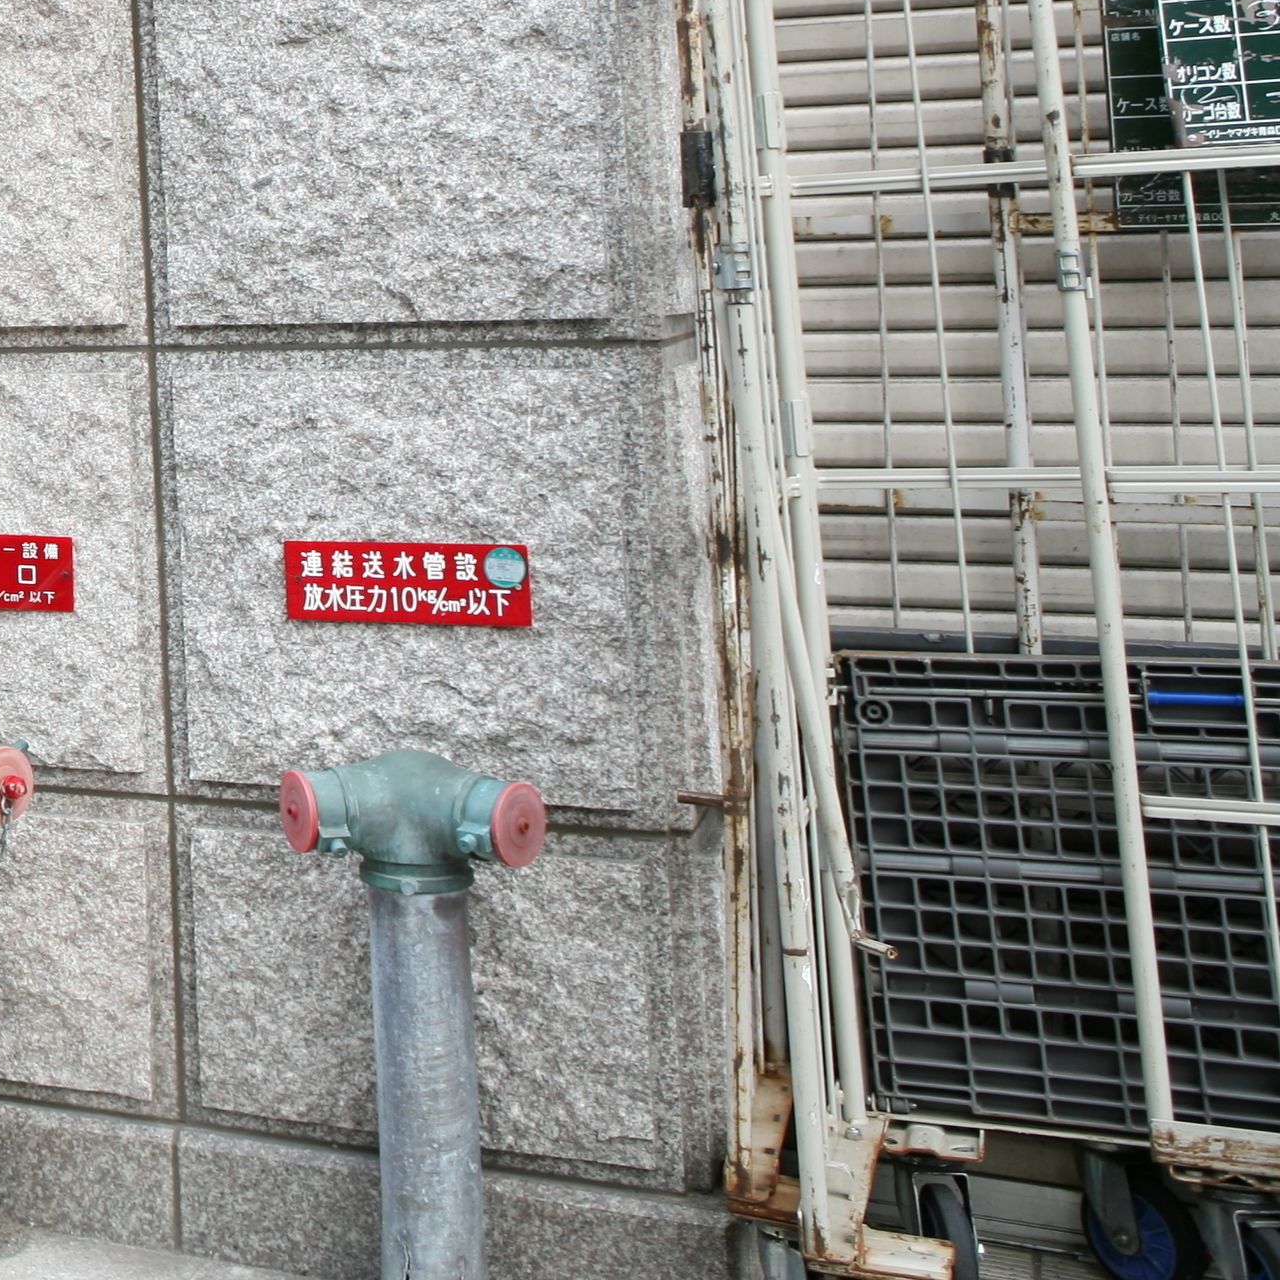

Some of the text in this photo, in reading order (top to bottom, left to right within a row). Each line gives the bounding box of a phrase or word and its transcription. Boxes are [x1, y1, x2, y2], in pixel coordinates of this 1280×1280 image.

[1168, 14, 1231, 36] ケース数
[1111, 32, 1141, 42] 店舗名
[1176, 61, 1238, 83] オリコン数
[1121, 189, 1181, 203] カーゴ台数
[299, 549, 479, 582] 連結送水管設
